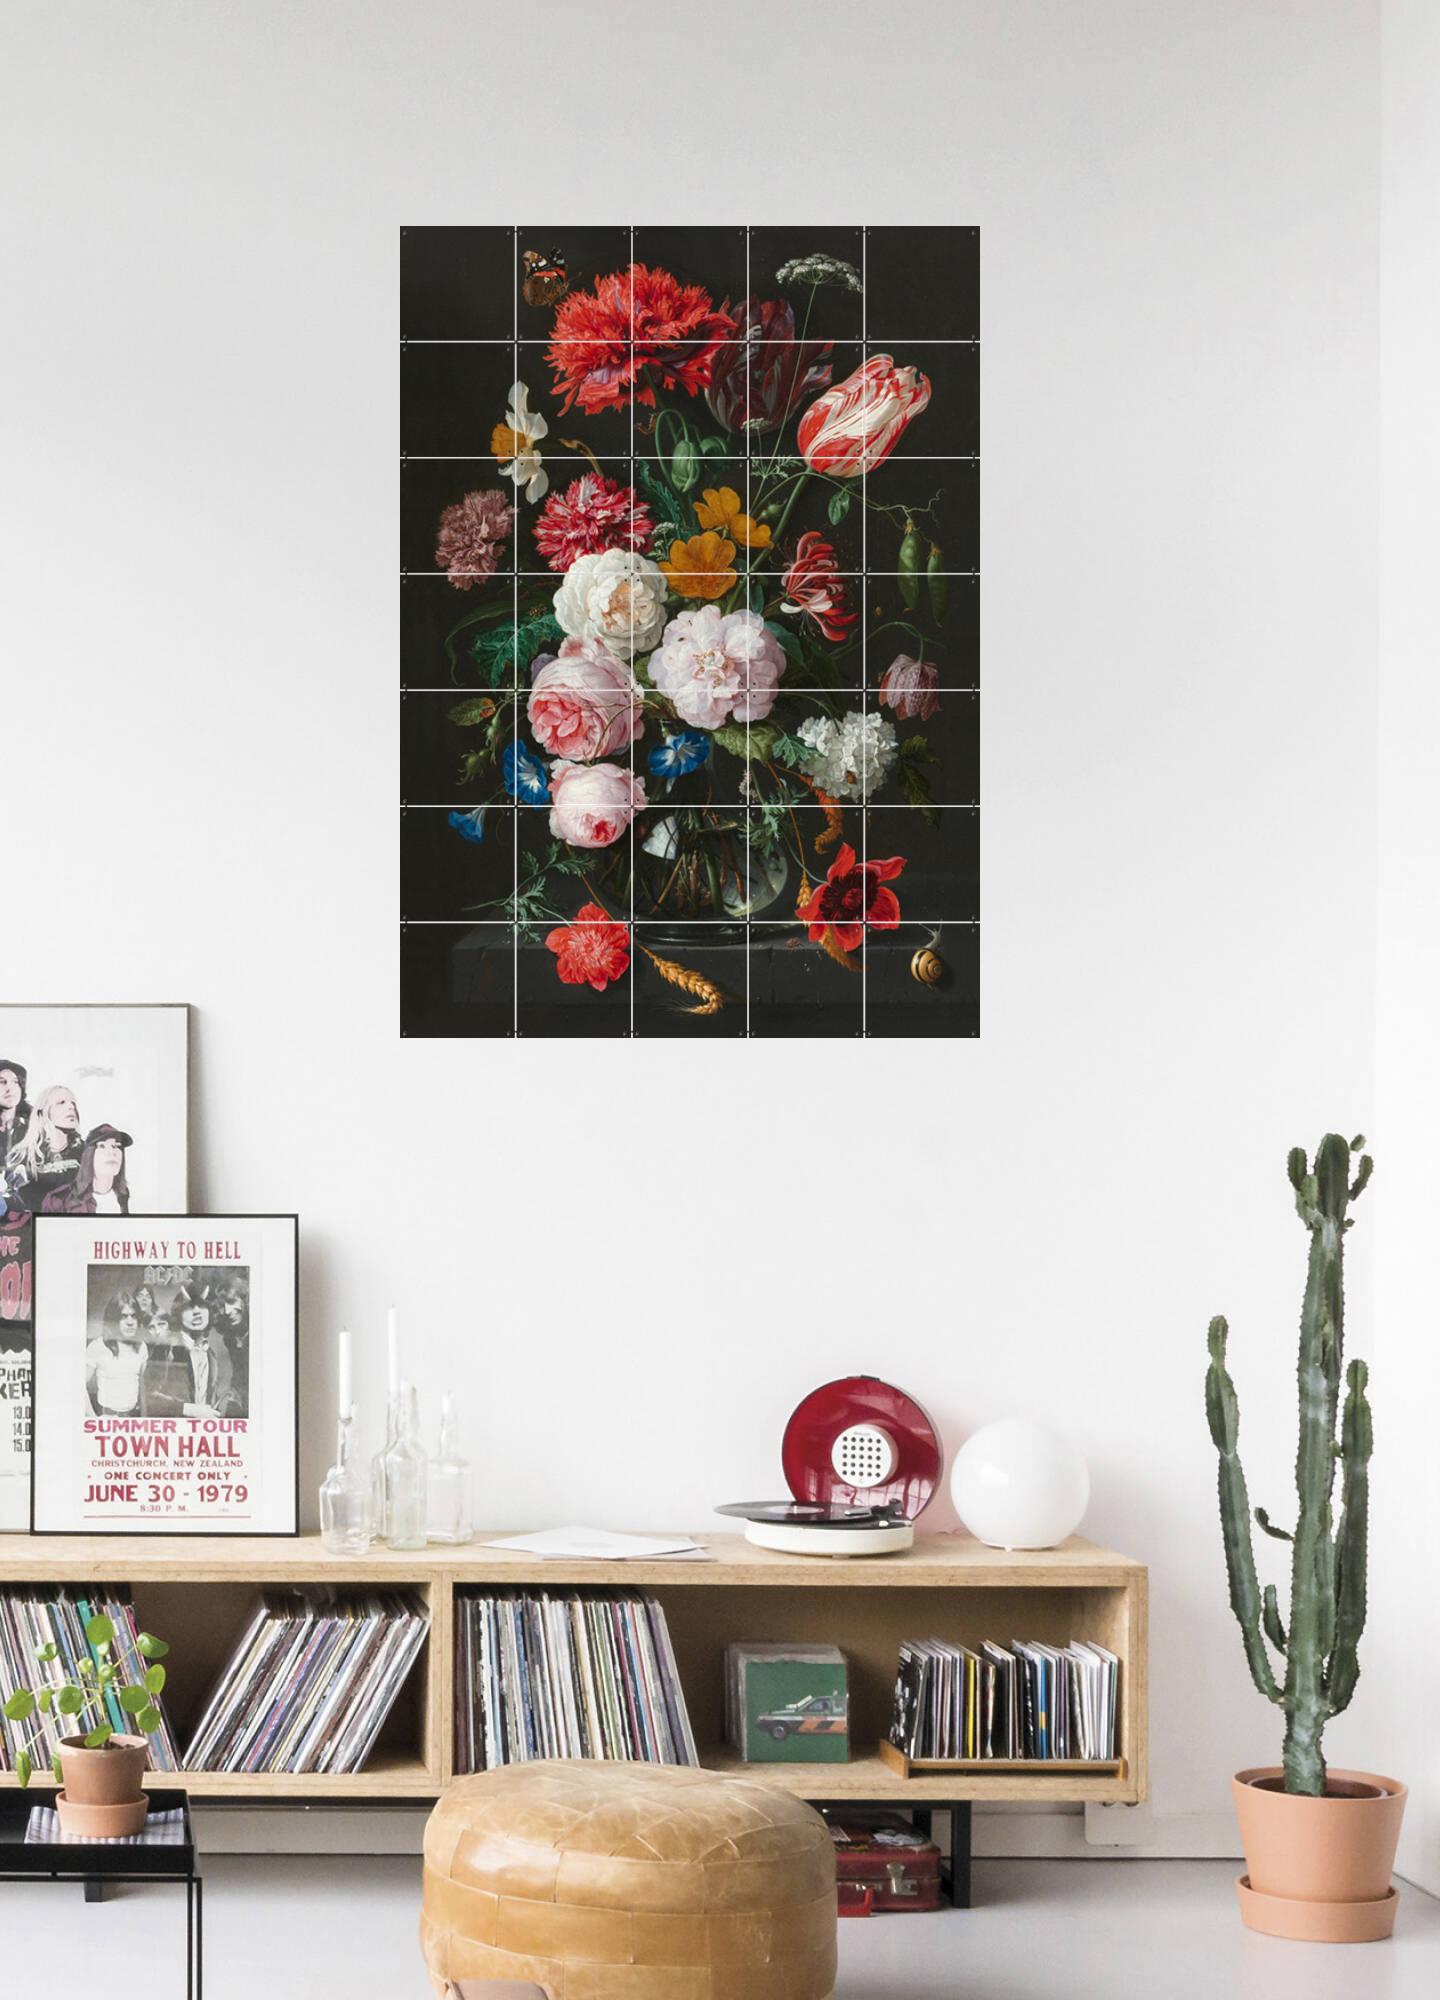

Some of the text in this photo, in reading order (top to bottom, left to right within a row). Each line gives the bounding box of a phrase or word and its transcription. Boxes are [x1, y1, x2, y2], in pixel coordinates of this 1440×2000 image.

[94, 1241, 241, 1259] HIGHWAY TO HELL
[83, 1419, 248, 1433] SUMMER TOUR
[94, 1436, 240, 1457] TOWN HALL
[173, 1460, 194, 1468] NEW
[199, 1460, 243, 1468] ZEALAND
[104, 1471, 231, 1481] ONE CONCERT ONLY
[83, 1485, 138, 1502] JUNE
[148, 1485, 176, 1502] 30
[197, 1485, 249, 1502] 1979
